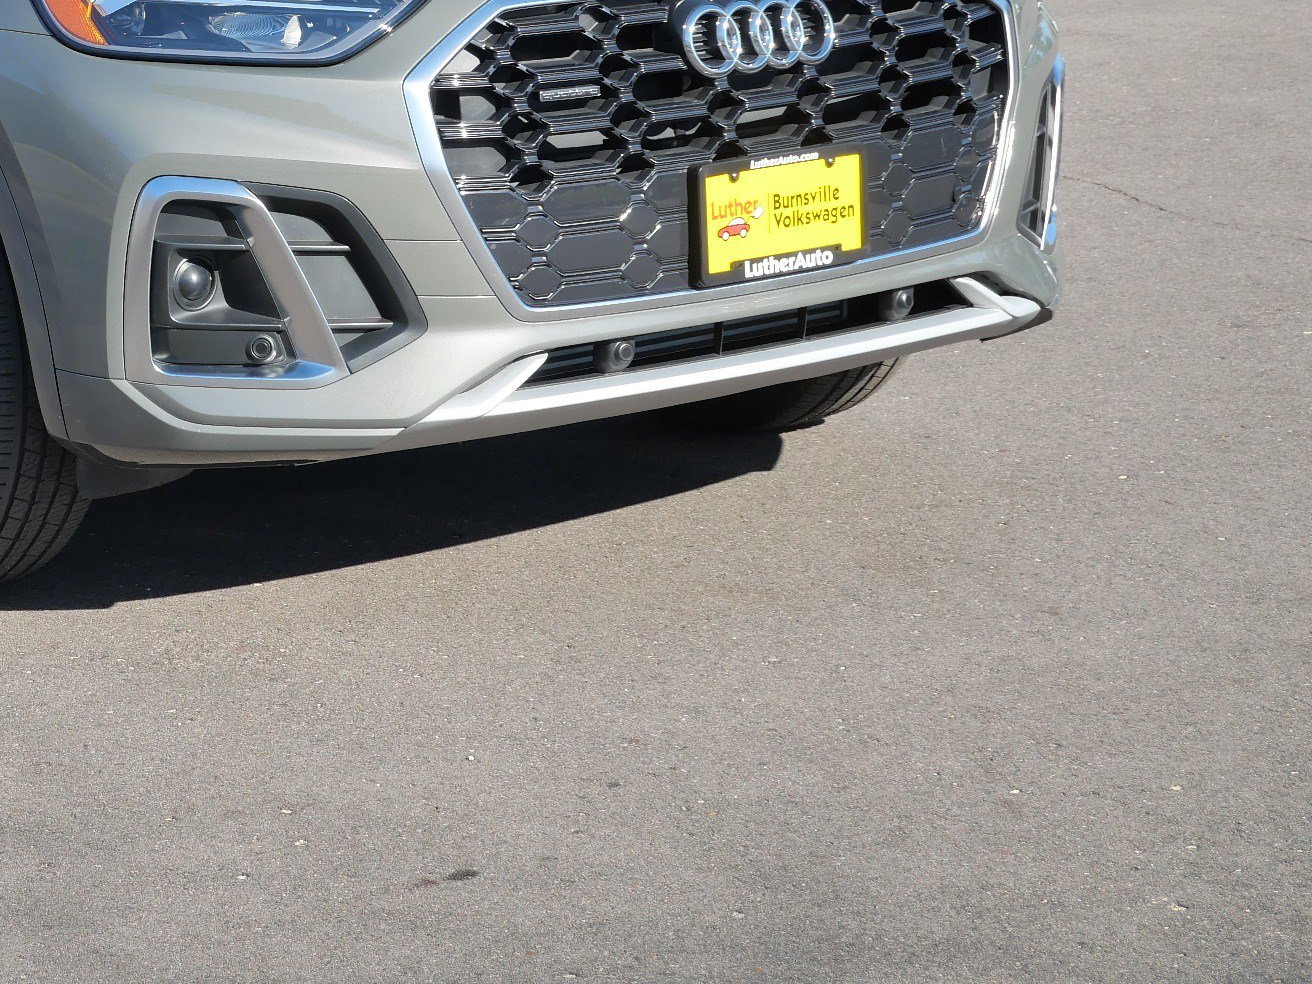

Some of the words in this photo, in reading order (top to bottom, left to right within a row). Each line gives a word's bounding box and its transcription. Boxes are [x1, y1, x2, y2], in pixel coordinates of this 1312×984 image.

[750, 152, 819, 170] LutherAuto.com
[711, 198, 759, 220] Luther
[773, 185, 840, 210] Burnsville
[774, 204, 855, 229] Volkswagen
[744, 249, 834, 278] LutherAuto
